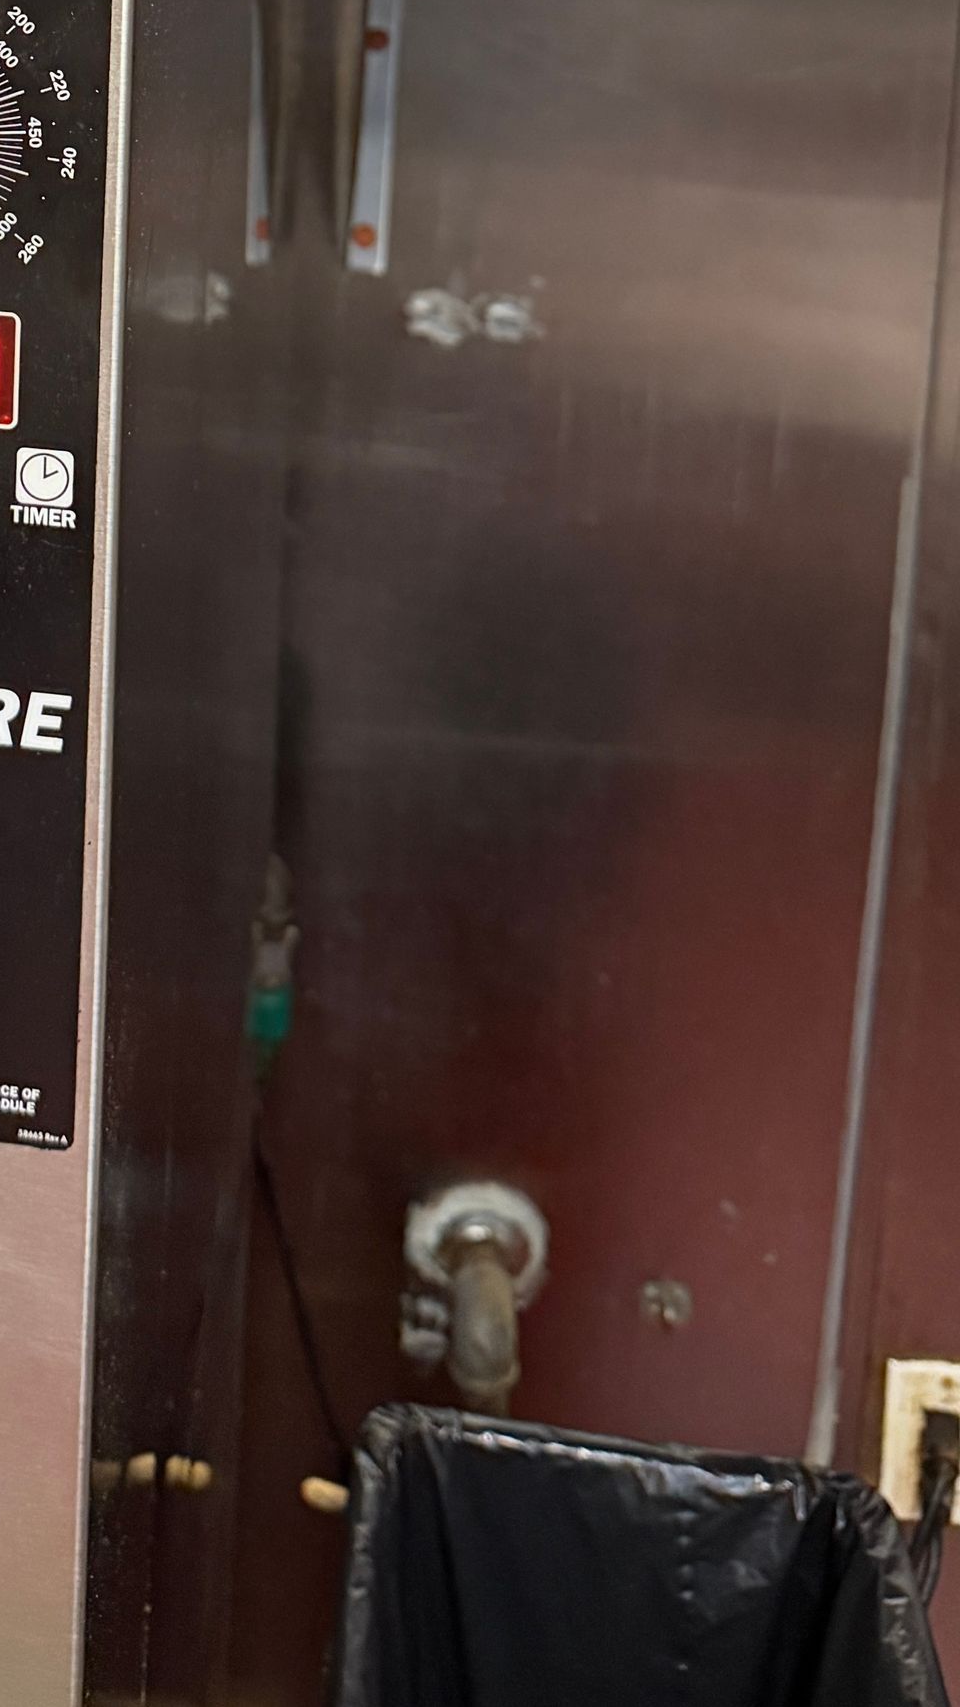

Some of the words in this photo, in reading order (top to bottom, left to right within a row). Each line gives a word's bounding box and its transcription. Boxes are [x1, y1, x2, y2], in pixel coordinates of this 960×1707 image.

[6, 6, 36, 35] 200
[49, 69, 71, 101] 220
[27, 116, 42, 149] 450
[60, 146, 78, 180] 240
[17, 234, 45, 265] 260
[10, 505, 77, 530] TIMER
[22, 1088, 41, 1103] OF
[60, 1134, 69, 1146] A
